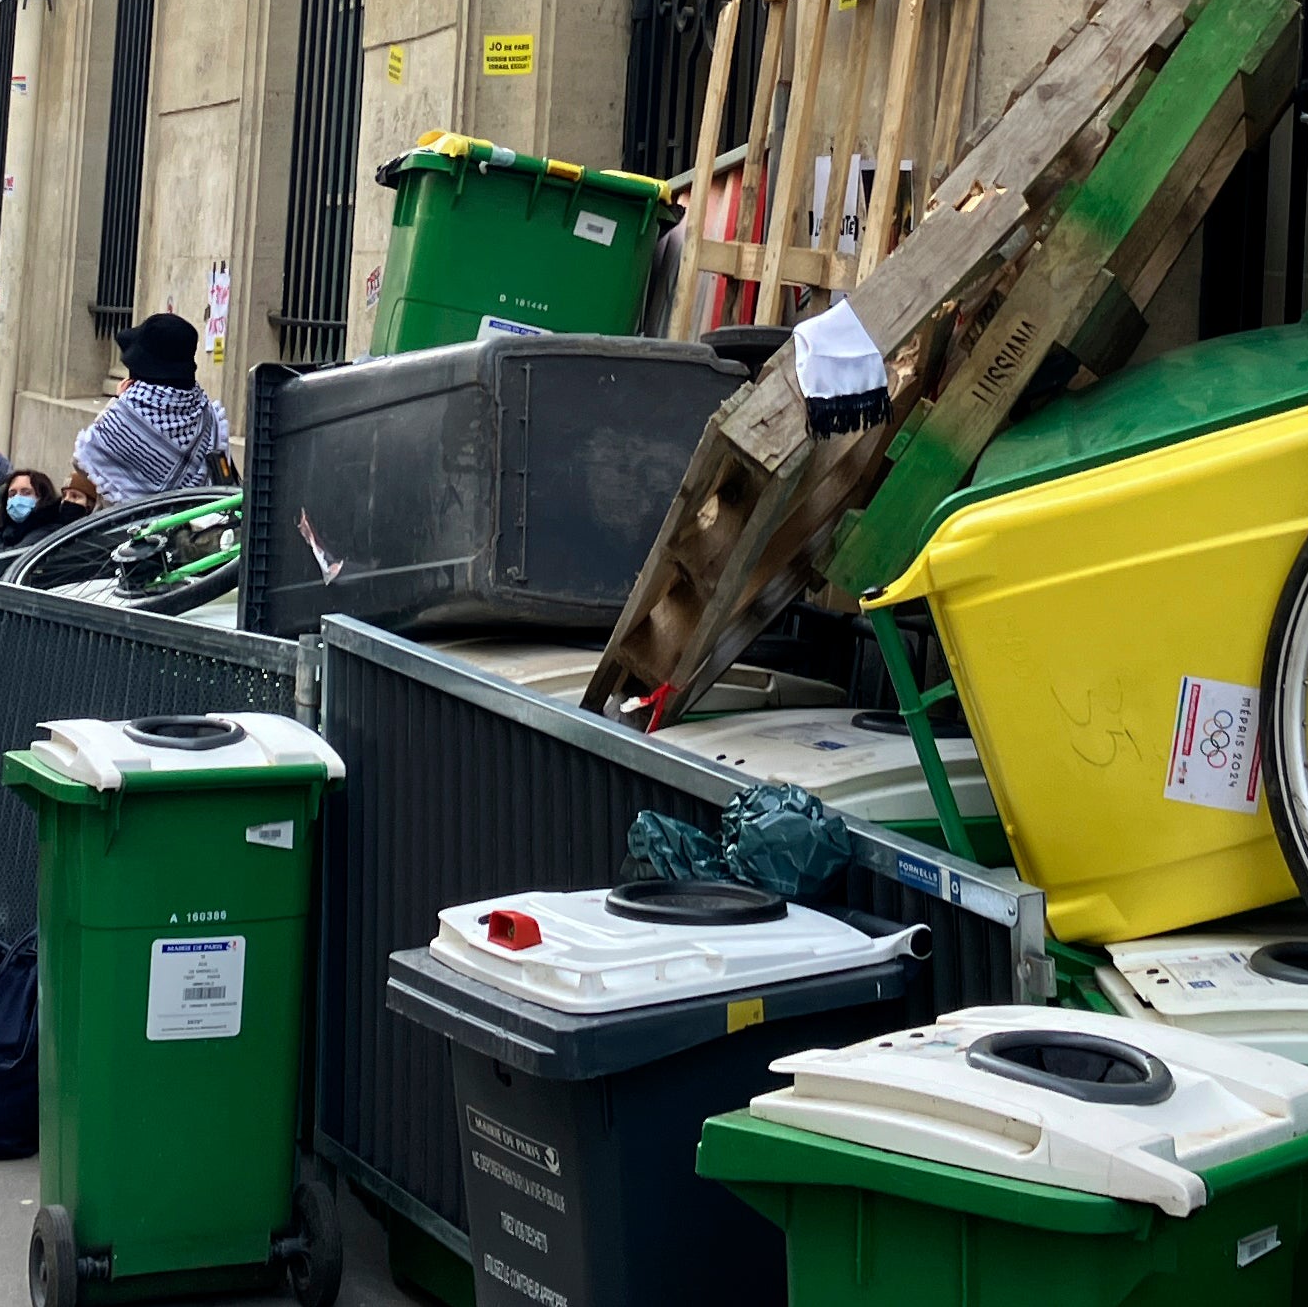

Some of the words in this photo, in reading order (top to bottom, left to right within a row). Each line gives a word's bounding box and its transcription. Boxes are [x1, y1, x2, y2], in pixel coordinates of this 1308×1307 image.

[489, 42, 502, 51] JO
[1235, 697, 1252, 747] MÉPRIS
[1229, 753, 1243, 788] 2024
[898, 859, 938, 882] FORNELLS
[169, 913, 178, 924] A
[515, 1138, 541, 1161] PARIS
